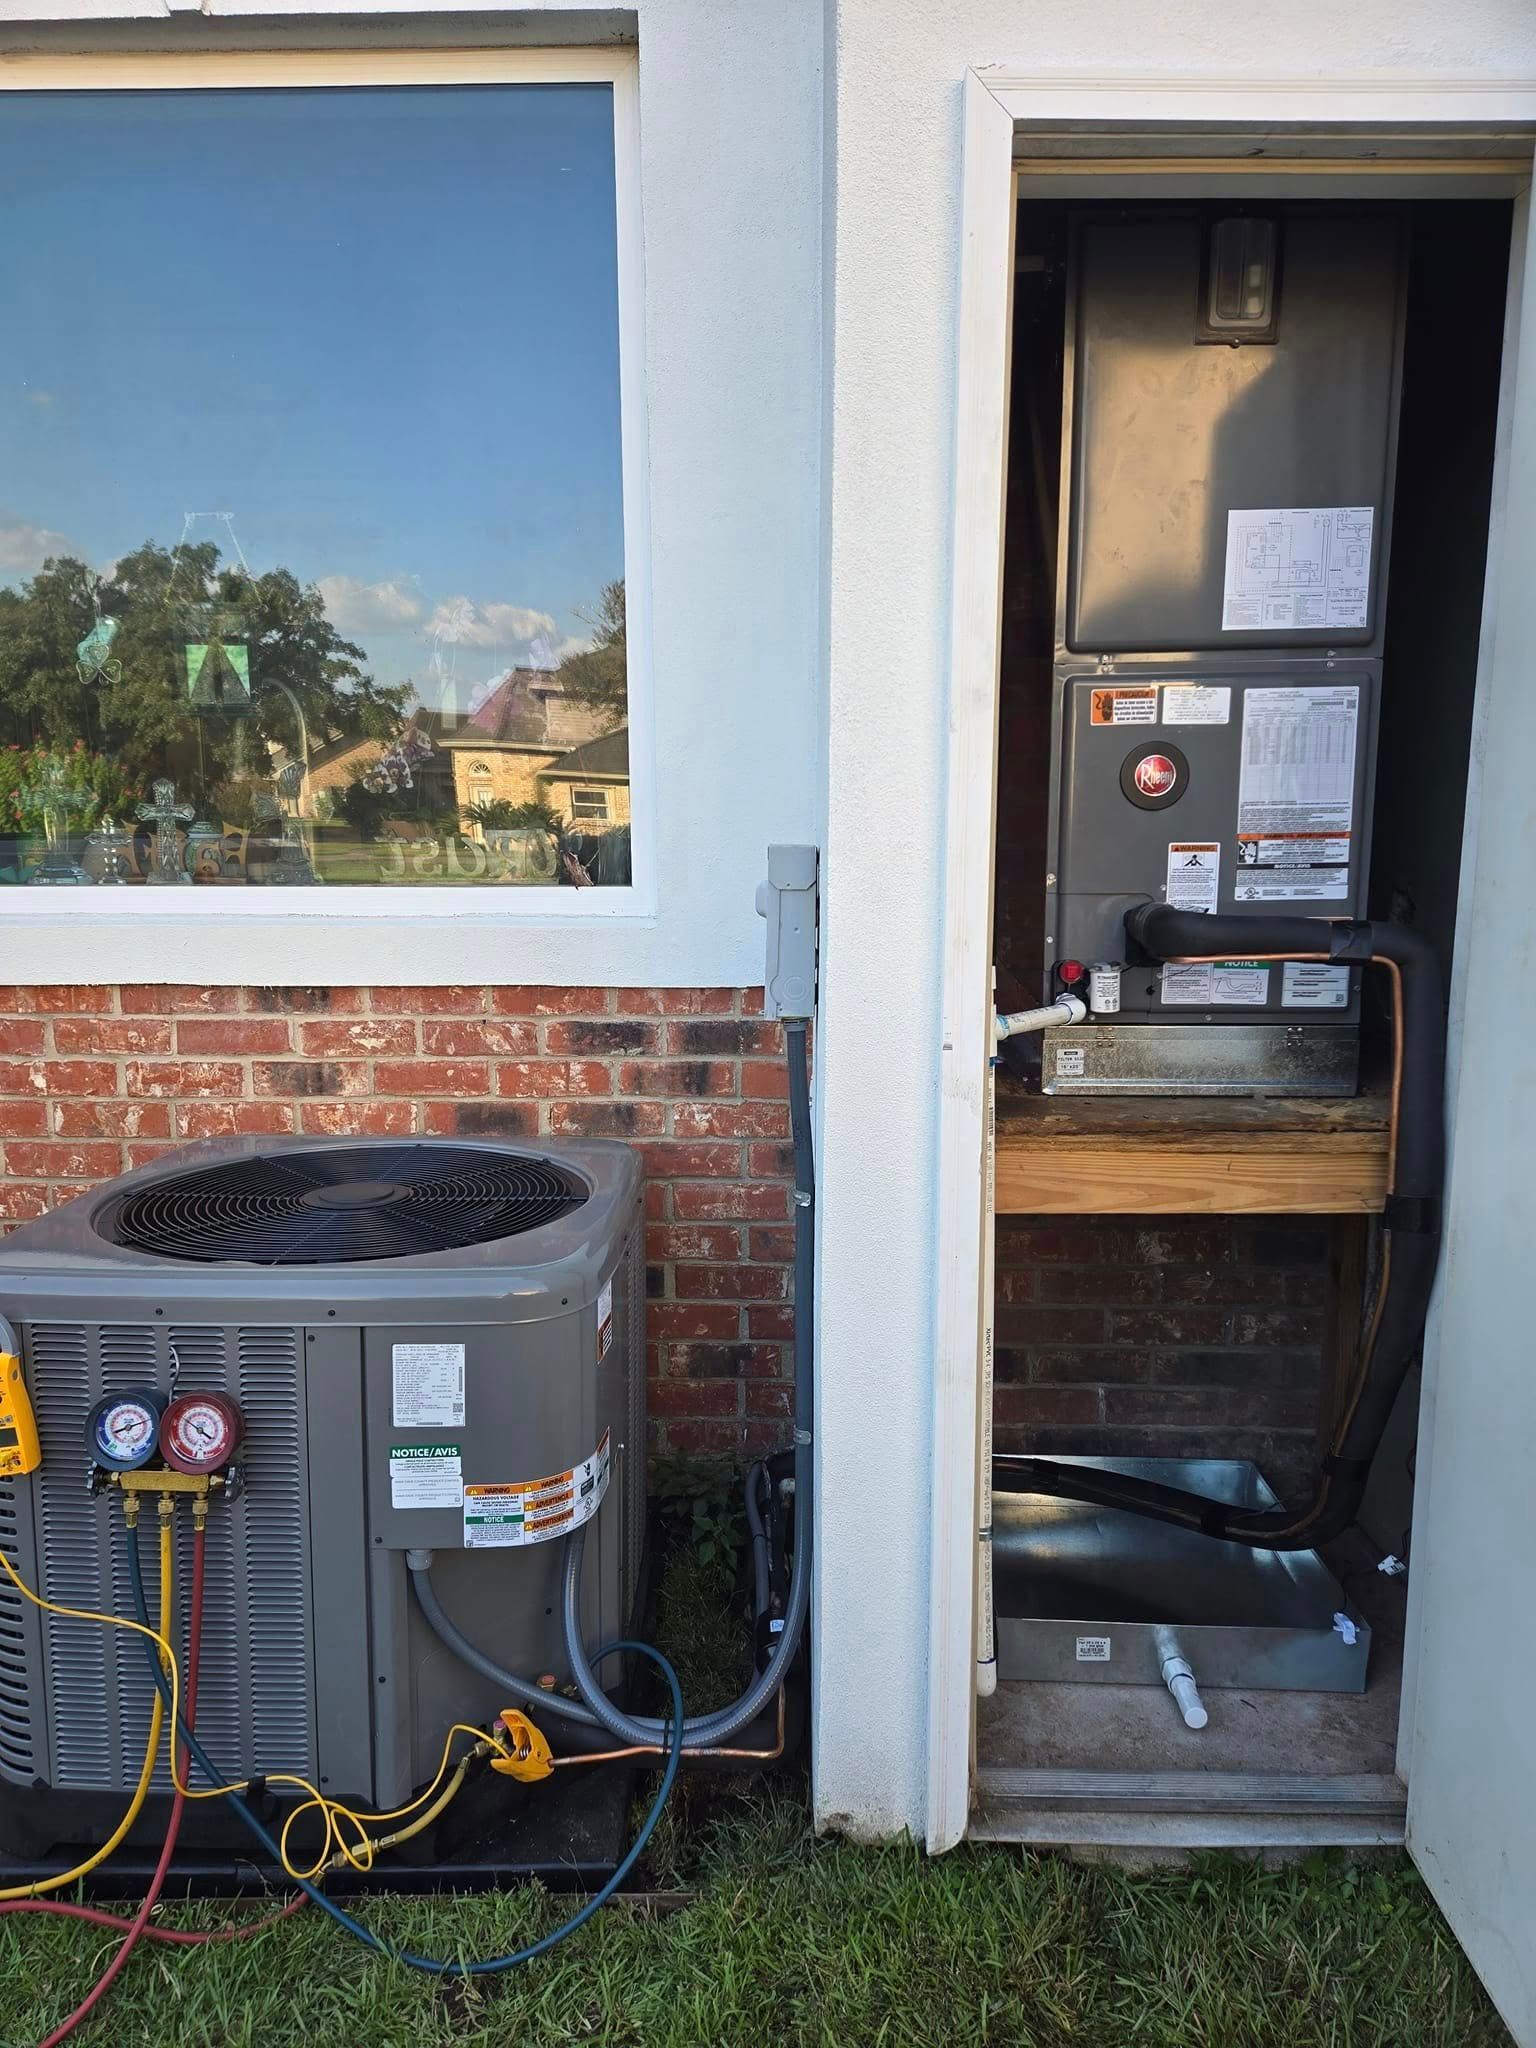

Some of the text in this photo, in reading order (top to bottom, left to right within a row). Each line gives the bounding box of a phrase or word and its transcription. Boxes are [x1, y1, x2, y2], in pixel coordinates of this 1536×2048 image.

[1140, 759, 1173, 789] Rheem
[391, 1447, 458, 1458] NOTICE/AVIS
[541, 1476, 565, 1489] WARNING
[483, 1486, 511, 1494] WARNING
